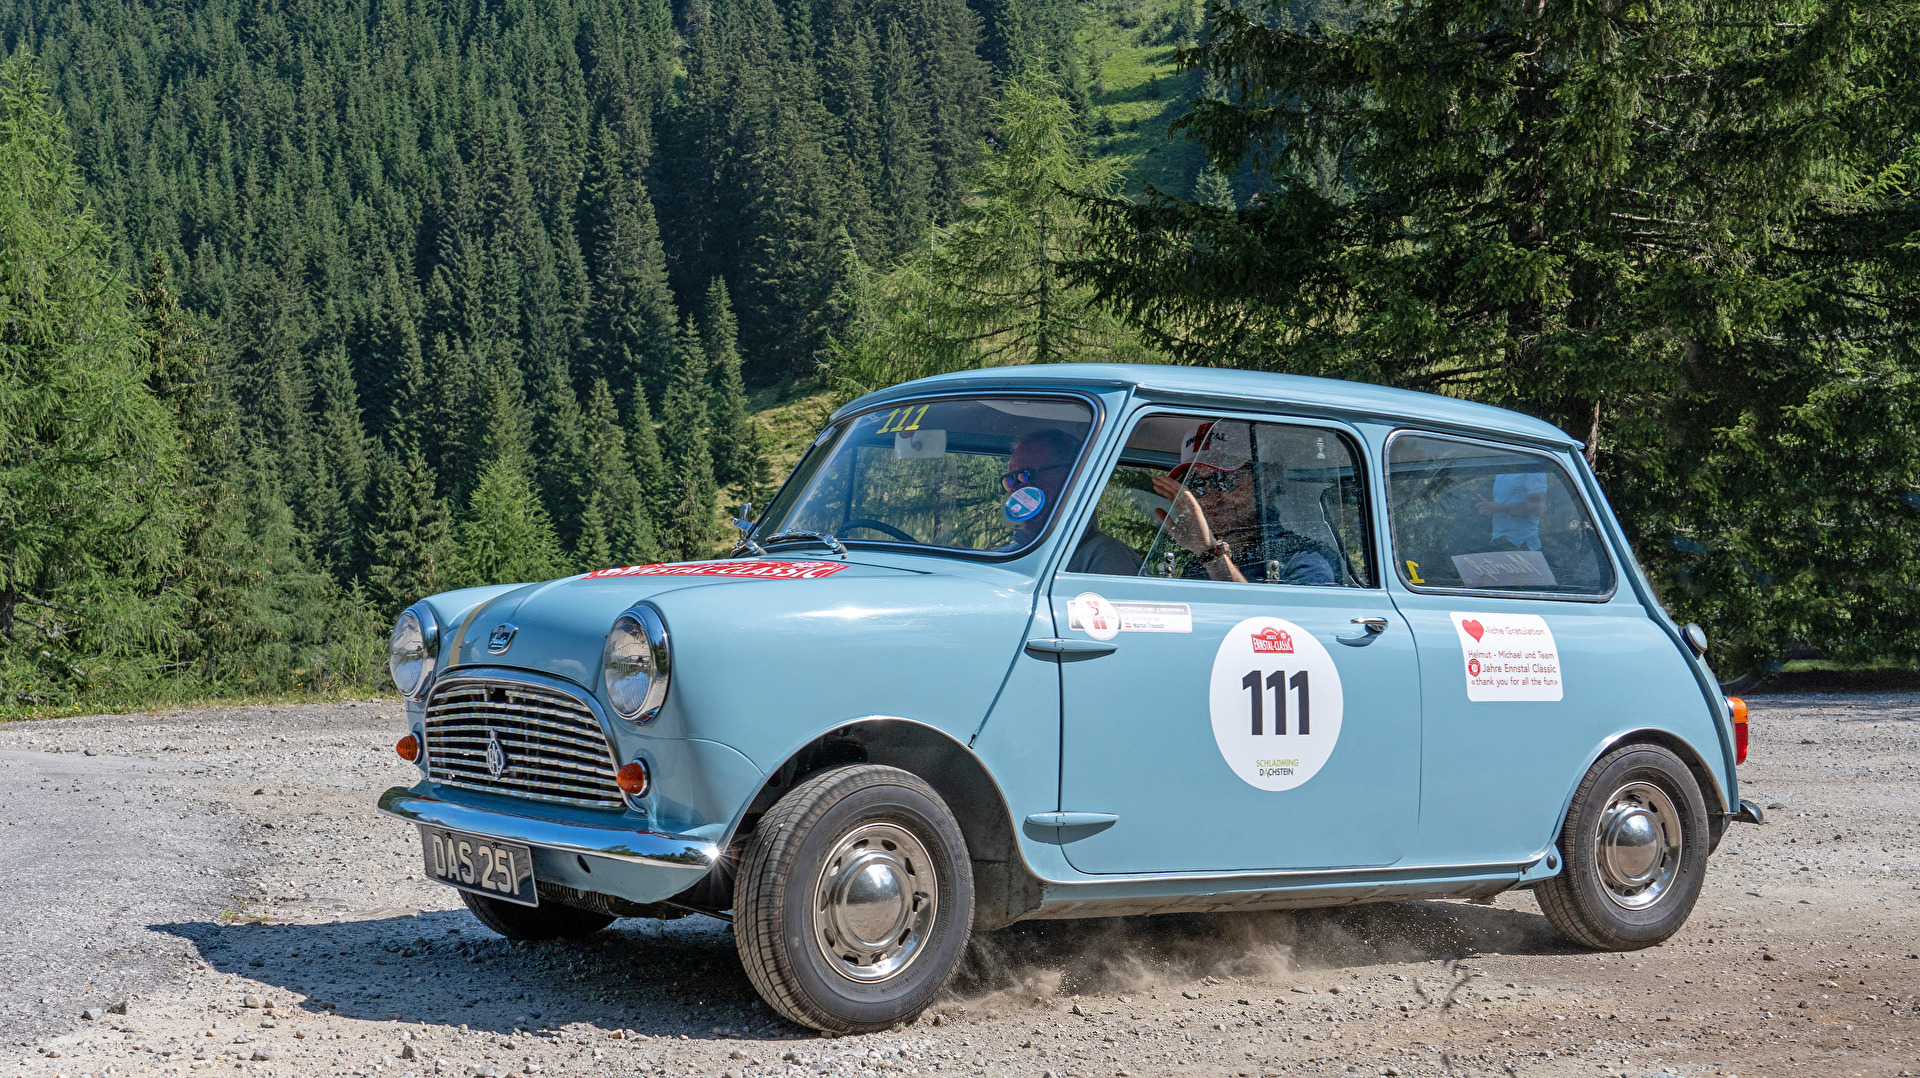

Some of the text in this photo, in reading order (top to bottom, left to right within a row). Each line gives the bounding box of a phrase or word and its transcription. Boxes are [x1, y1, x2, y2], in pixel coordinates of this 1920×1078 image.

[876, 404, 930, 434] 111
[1505, 627, 1545, 636] Gratulation
[1467, 650, 1492, 659] Helmut
[1498, 650, 1523, 659] Michael
[1524, 651, 1536, 659] und
[1537, 651, 1555, 659] Team
[1482, 663, 1502, 673] Jahre
[1504, 663, 1530, 673] Ennstal
[1532, 663, 1557, 673] Classic
[1496, 678, 1508, 688] you
[1510, 677, 1520, 686] for
[1521, 677, 1530, 686] all
[1531, 677, 1542, 686] the
[1242, 670, 1310, 735] 111
[1256, 759, 1299, 768] SCHLADMING
[432, 833, 520, 896] DAS 251
